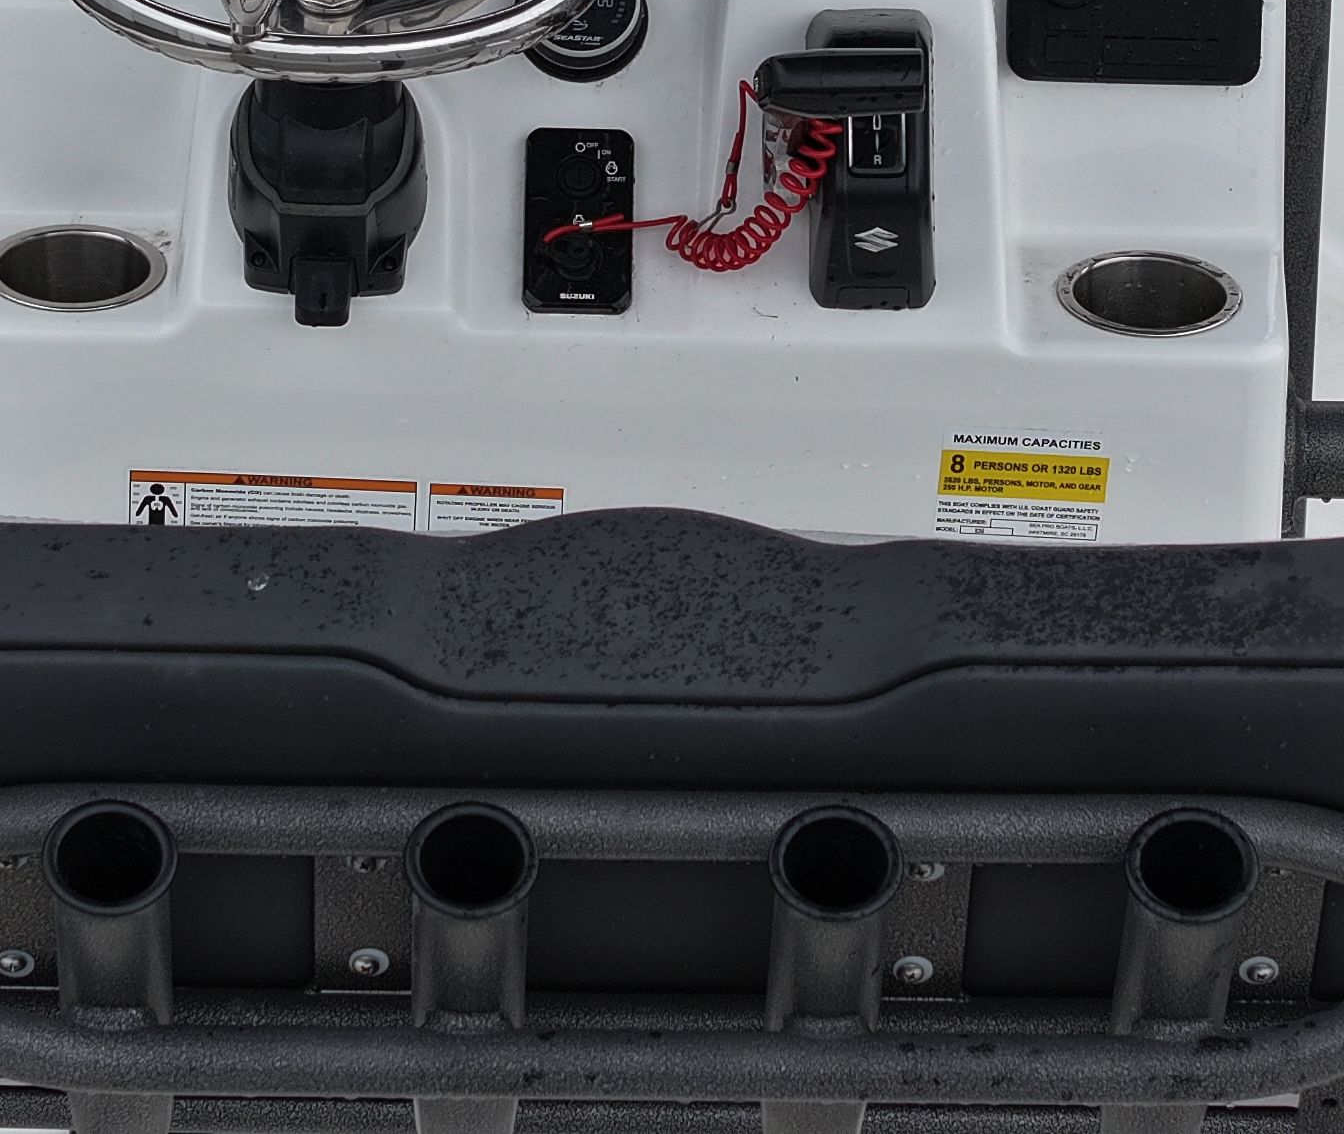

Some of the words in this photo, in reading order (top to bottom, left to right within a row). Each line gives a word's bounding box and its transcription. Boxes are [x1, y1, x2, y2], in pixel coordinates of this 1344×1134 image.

[873, 154, 882, 165] R
[953, 434, 1018, 446] MAXIMUM
[1021, 438, 1102, 450] CAPACITIES
[950, 454, 965, 474] 8
[974, 461, 1029, 473] PERSONS
[1032, 464, 1049, 474] OR
[1052, 464, 1077, 475] 1320
[1079, 466, 1102, 476] LBS
[247, 476, 313, 487] WARNING
[1078, 483, 1101, 491] GEAR
[470, 485, 536, 497] WARNING
